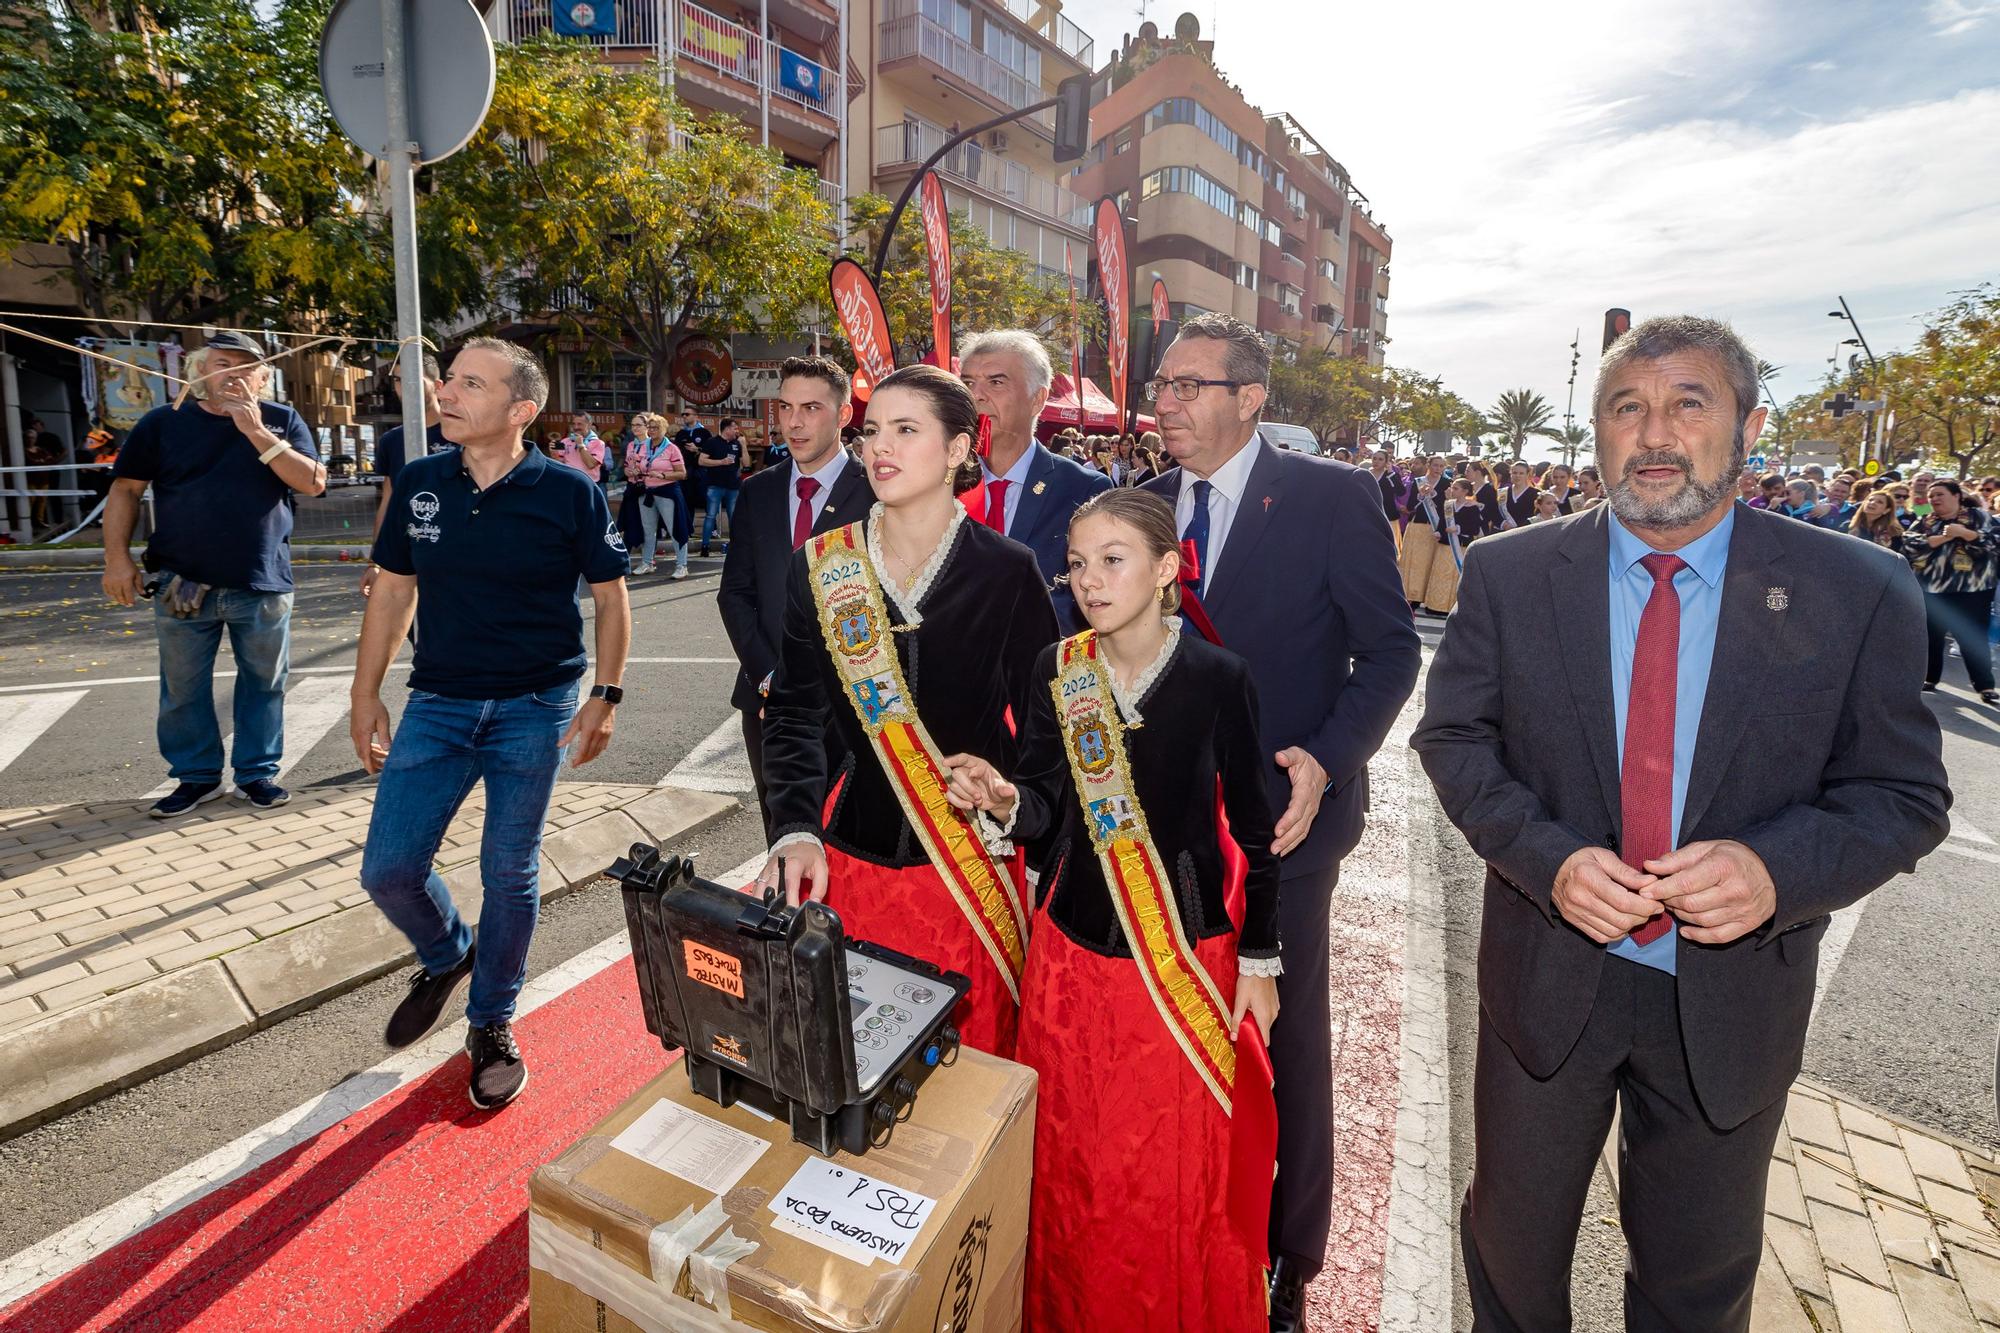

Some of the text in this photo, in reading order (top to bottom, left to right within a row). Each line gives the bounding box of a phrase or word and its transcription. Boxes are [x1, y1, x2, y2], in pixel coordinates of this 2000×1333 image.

[703, 378, 729, 402] EXPRESS
[821, 562, 861, 586] 2022
[824, 583, 870, 609] FESTES MAJORS
[848, 648, 880, 666] BENIDORM
[1062, 672, 1096, 697] 2022
[1079, 696, 1104, 710] MAJORS
[1086, 768, 1115, 785] BENIDORM
[693, 968, 738, 993] MASTER
[786, 1196, 832, 1225] ROJA
[865, 1188, 924, 1230] POS
